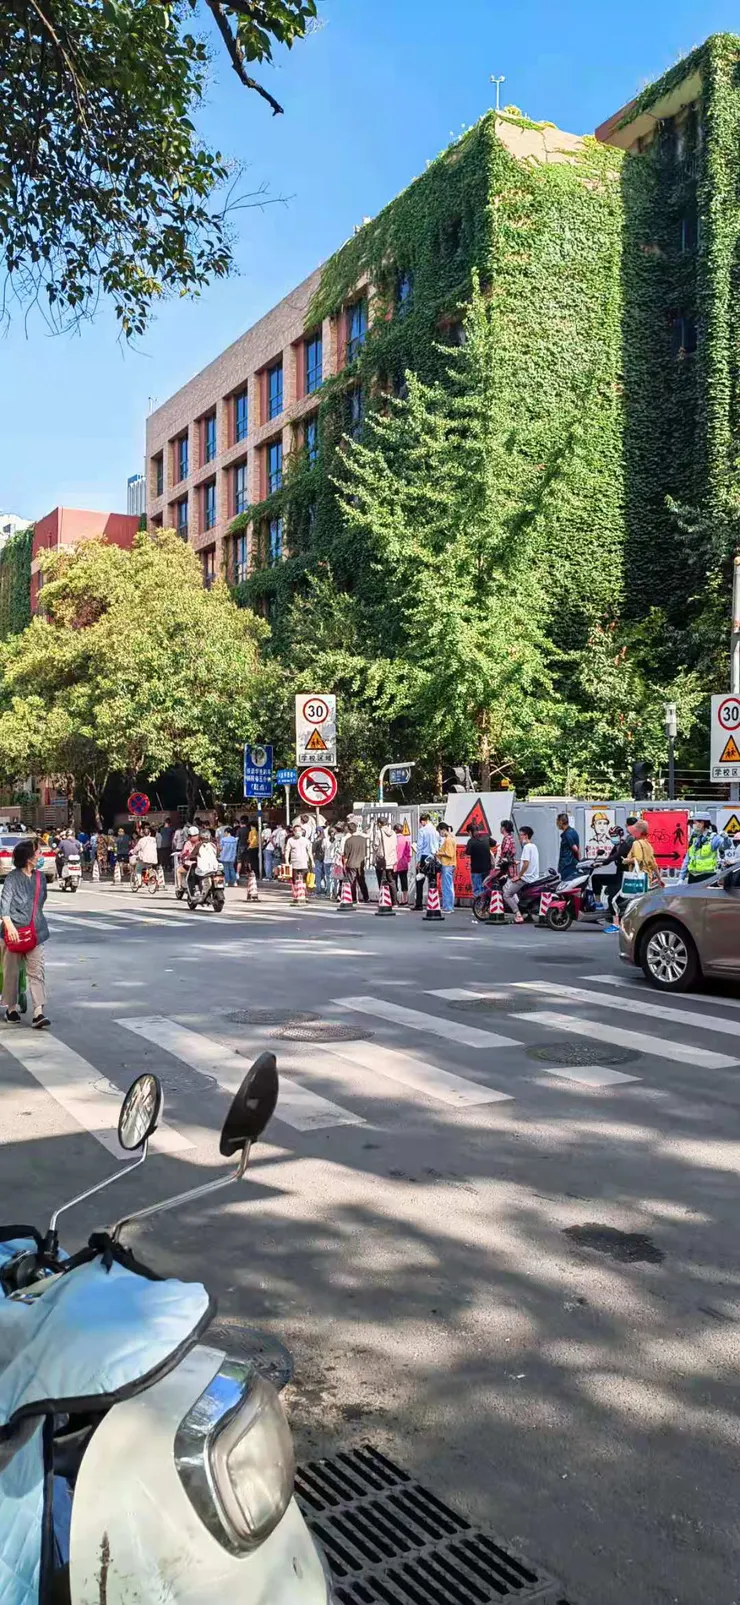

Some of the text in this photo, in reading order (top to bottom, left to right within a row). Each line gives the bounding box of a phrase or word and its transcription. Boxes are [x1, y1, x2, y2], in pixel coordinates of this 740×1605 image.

[308, 705, 323, 717] 30
[723, 706, 739, 721] 30
[301, 754, 331, 762] 学校区域
